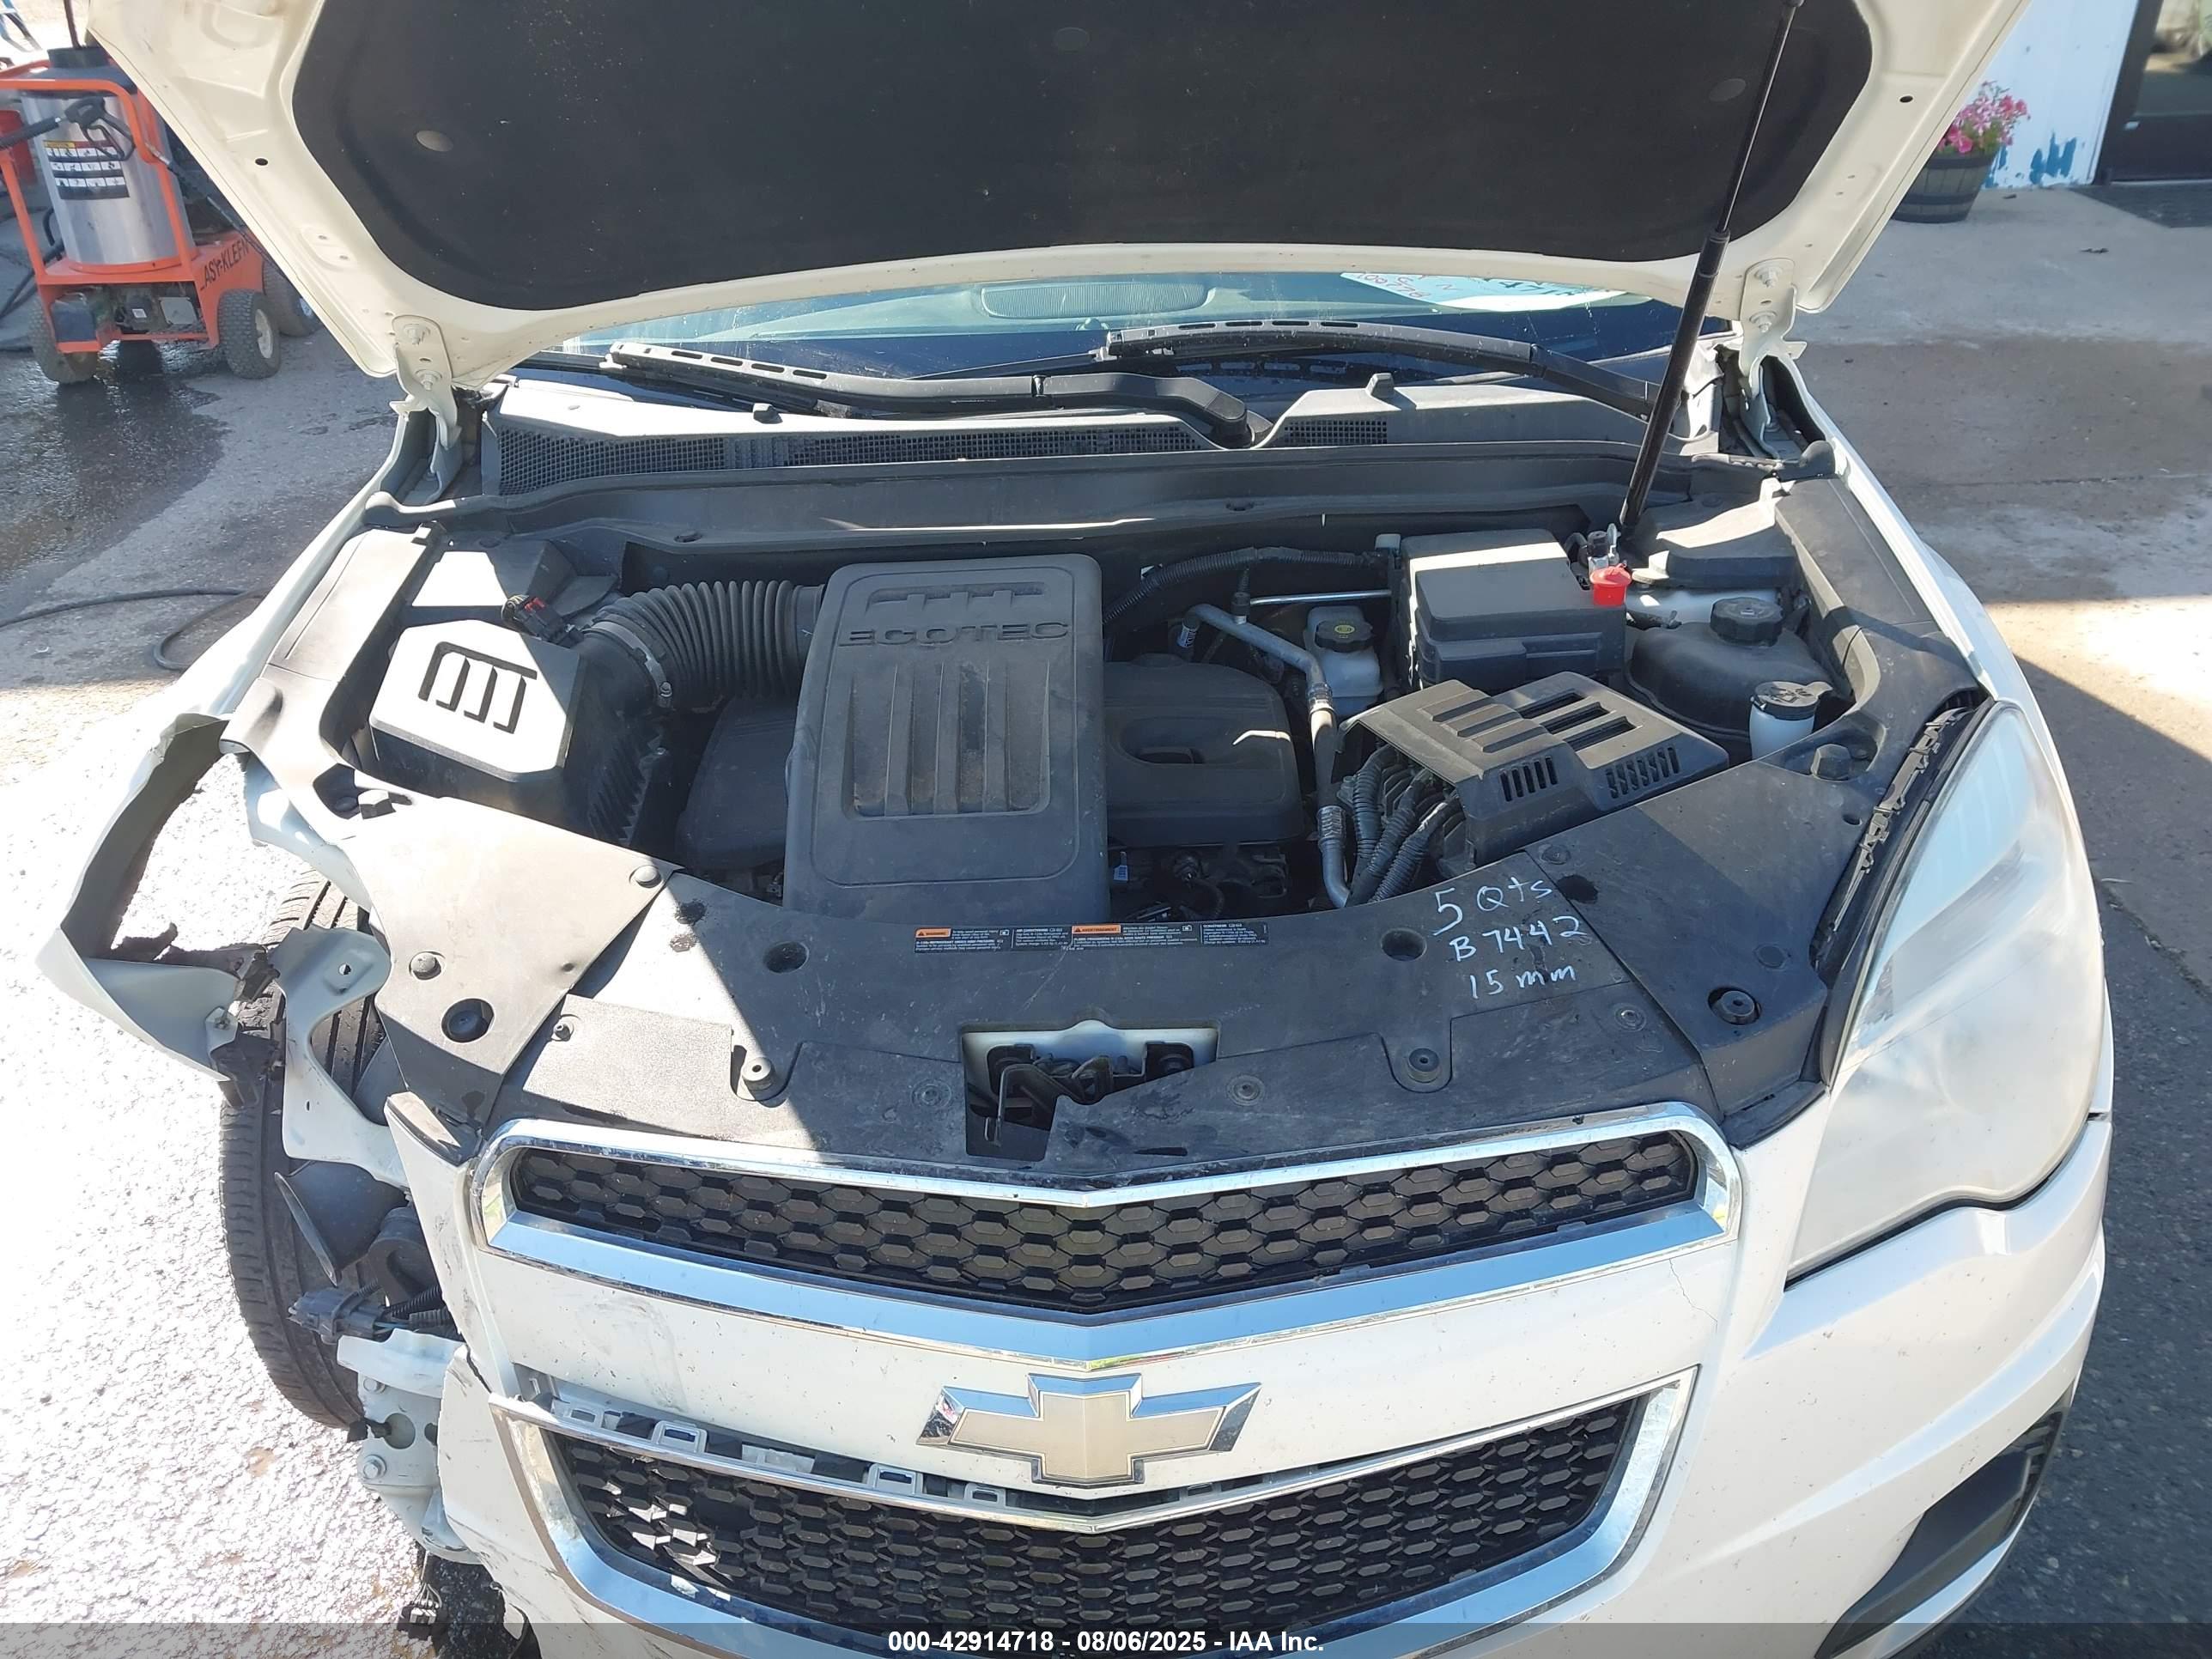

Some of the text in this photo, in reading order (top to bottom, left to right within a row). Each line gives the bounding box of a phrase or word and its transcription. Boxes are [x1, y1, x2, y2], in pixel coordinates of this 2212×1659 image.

[837, 621, 1069, 647] ECOTEC
[1431, 876, 1553, 936] 5 Qts
[1469, 964, 1577, 1000] 15 mm
